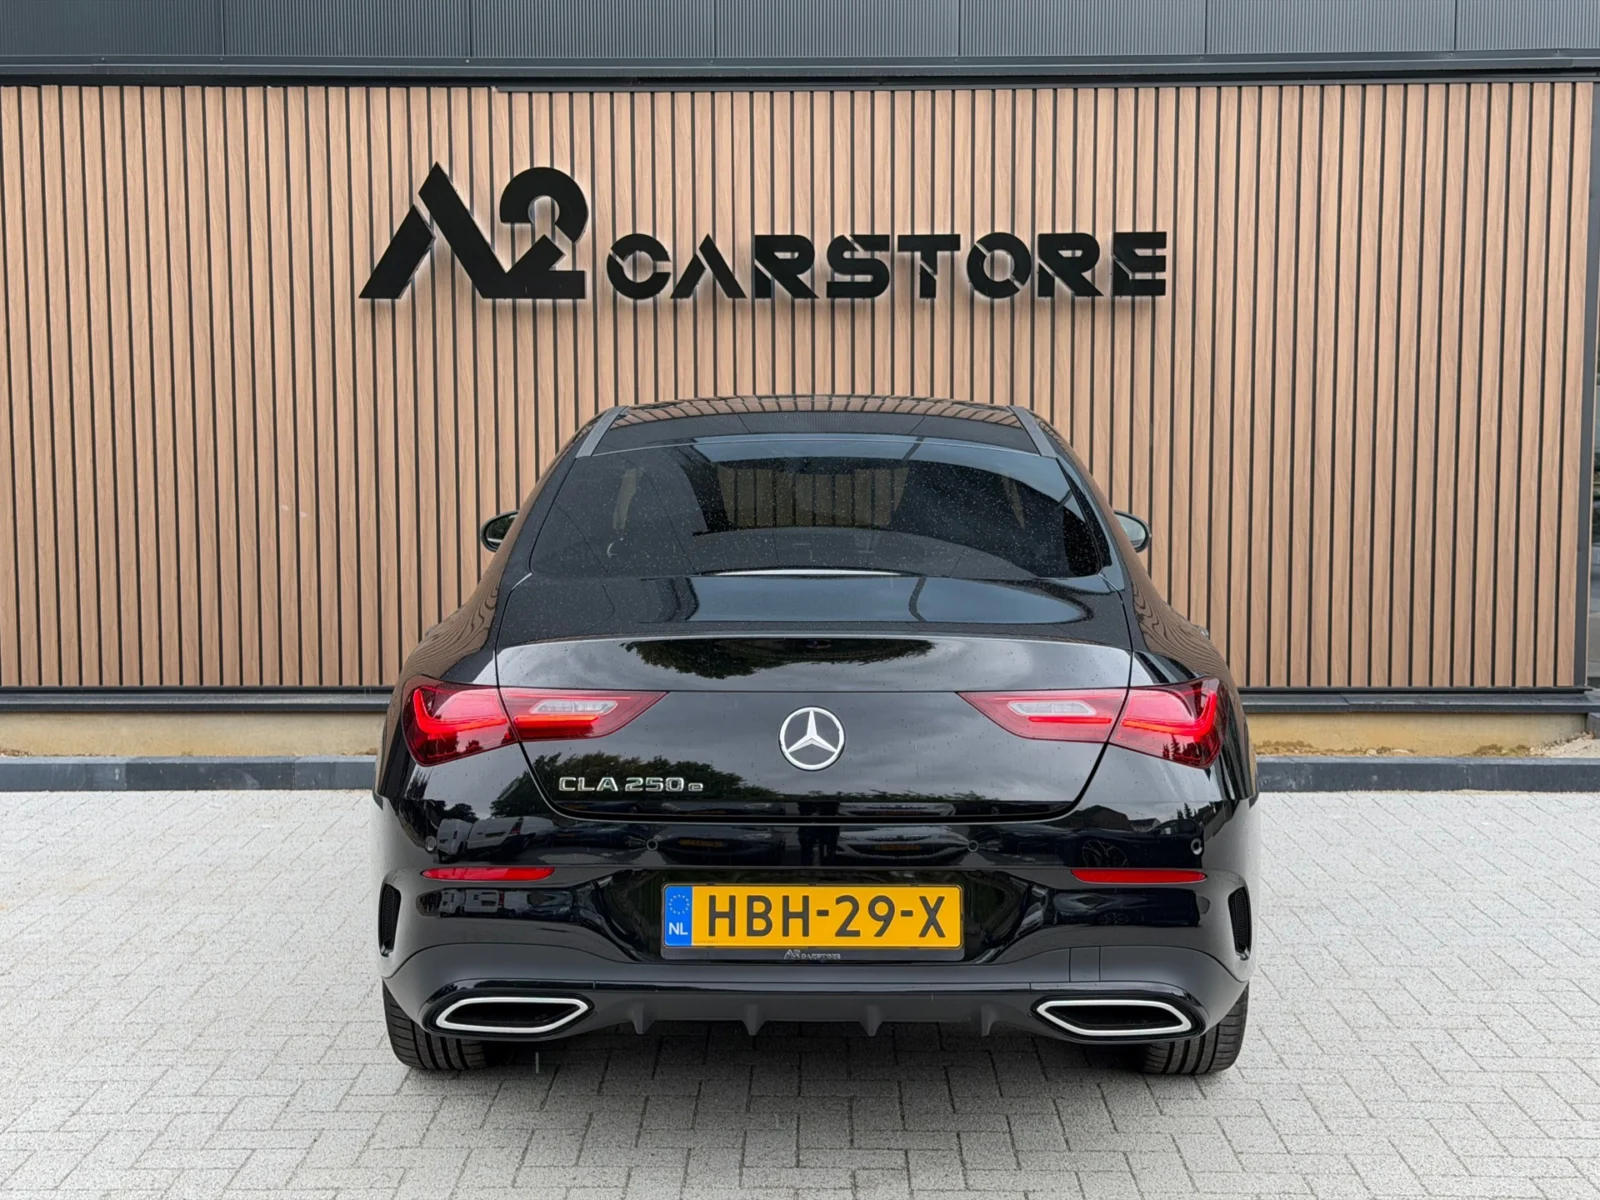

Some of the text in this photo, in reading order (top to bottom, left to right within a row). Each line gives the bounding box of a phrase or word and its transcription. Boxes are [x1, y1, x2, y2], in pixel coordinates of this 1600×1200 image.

[358, 161, 1167, 300] A2 CARSTORE
[558, 776, 619, 792] CLA
[668, 922, 689, 936] NL
[707, 894, 947, 939] HBH-29-X
